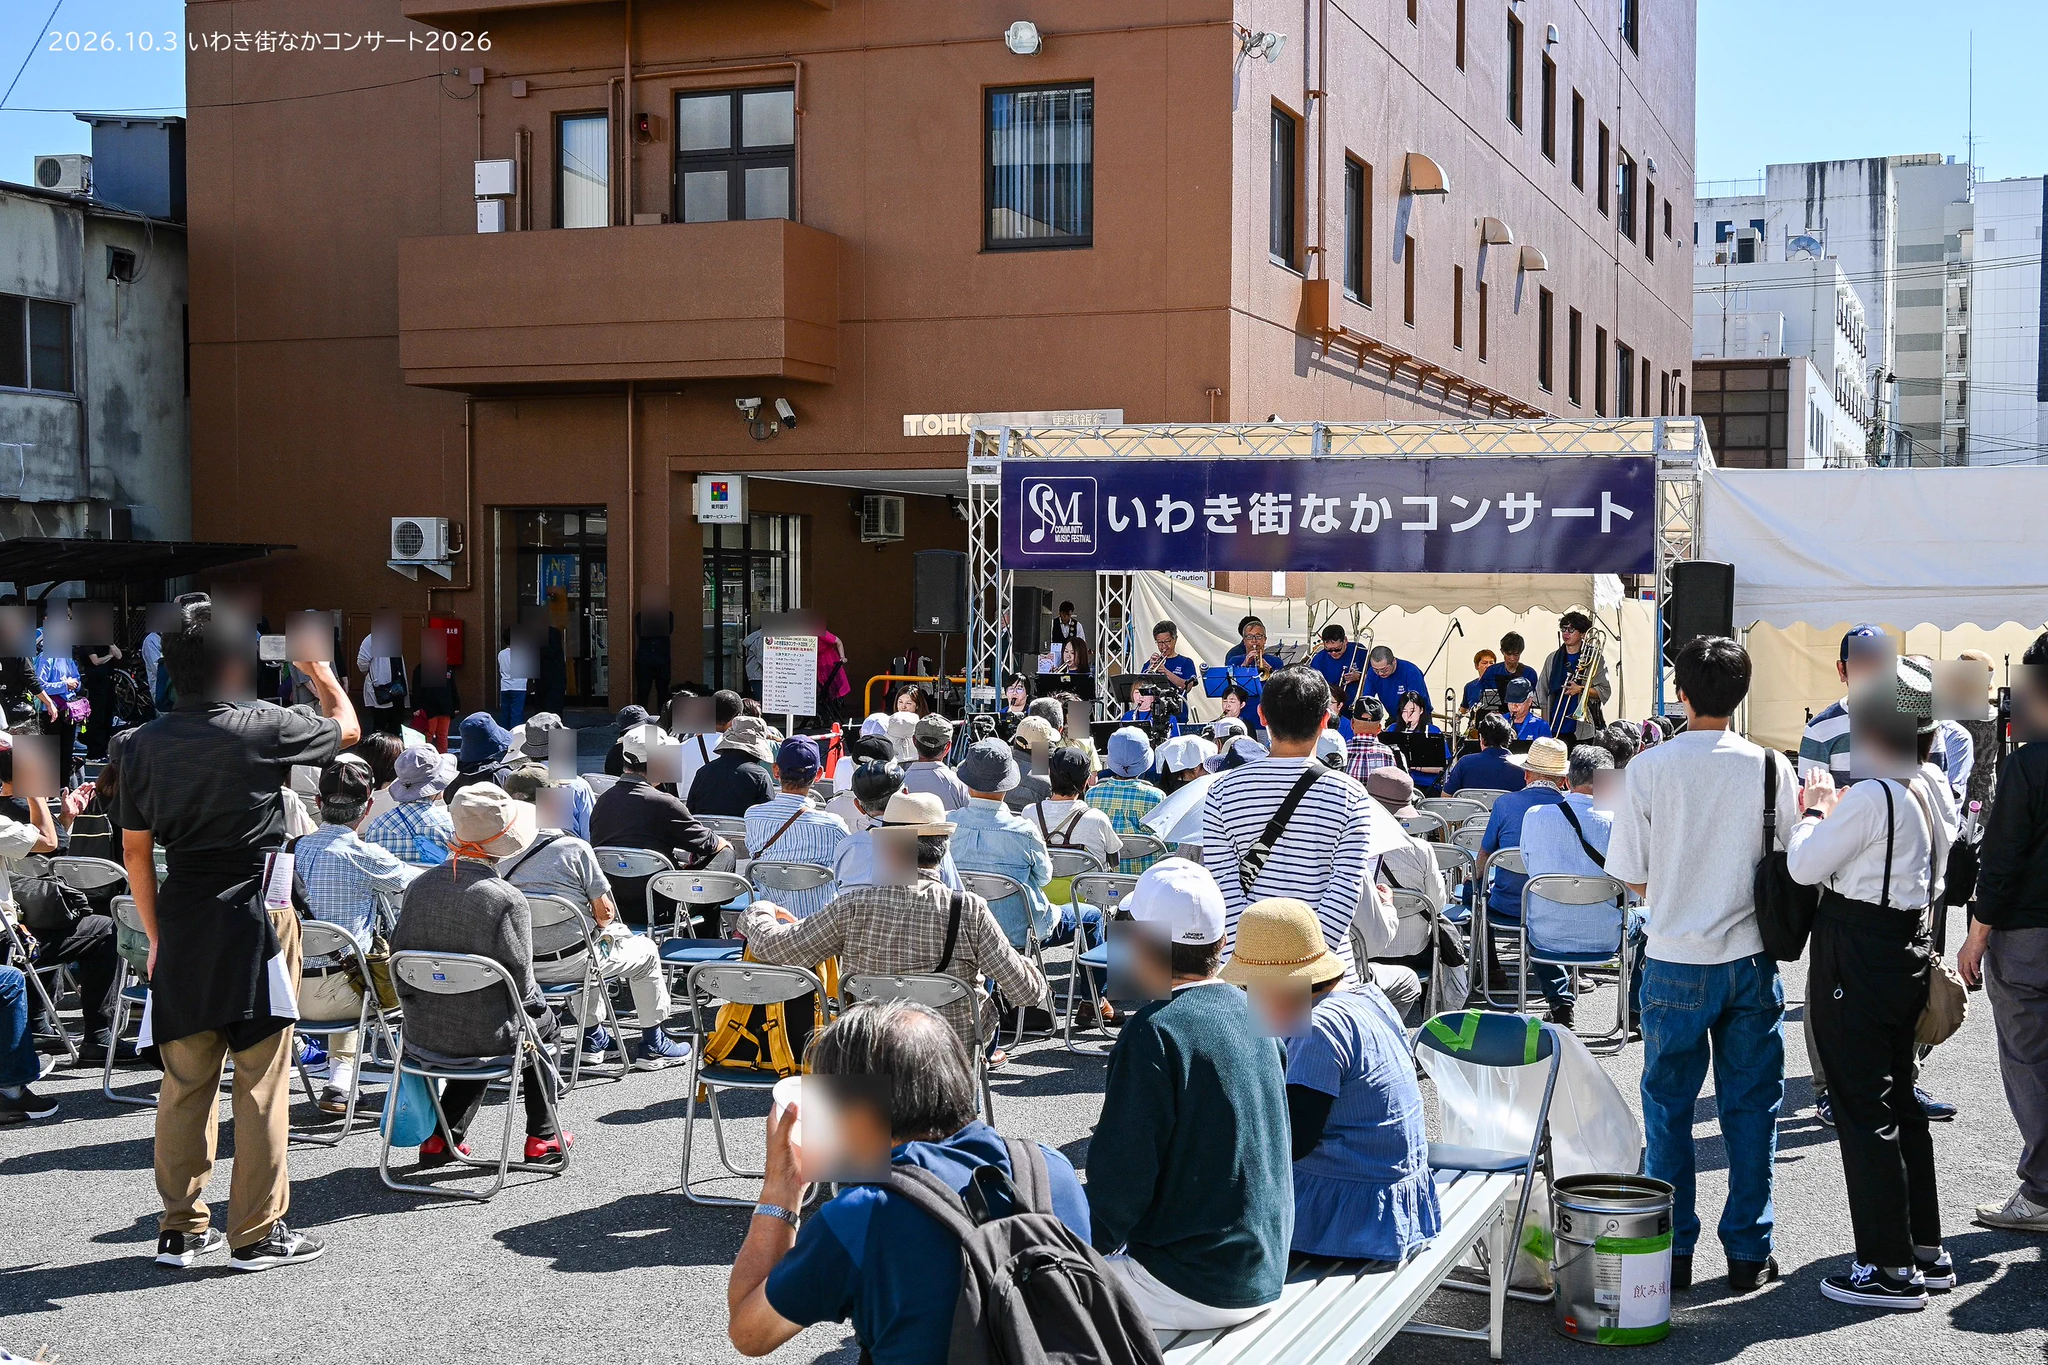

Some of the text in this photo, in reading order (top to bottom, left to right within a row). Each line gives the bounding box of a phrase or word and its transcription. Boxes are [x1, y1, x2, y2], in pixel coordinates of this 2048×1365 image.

[1107, 491, 1634, 535] いわき街なかコンサート
[1054, 525, 1083, 534] COMMUNITY
[1054, 534, 1092, 543] MUSIC FESTIVAL
